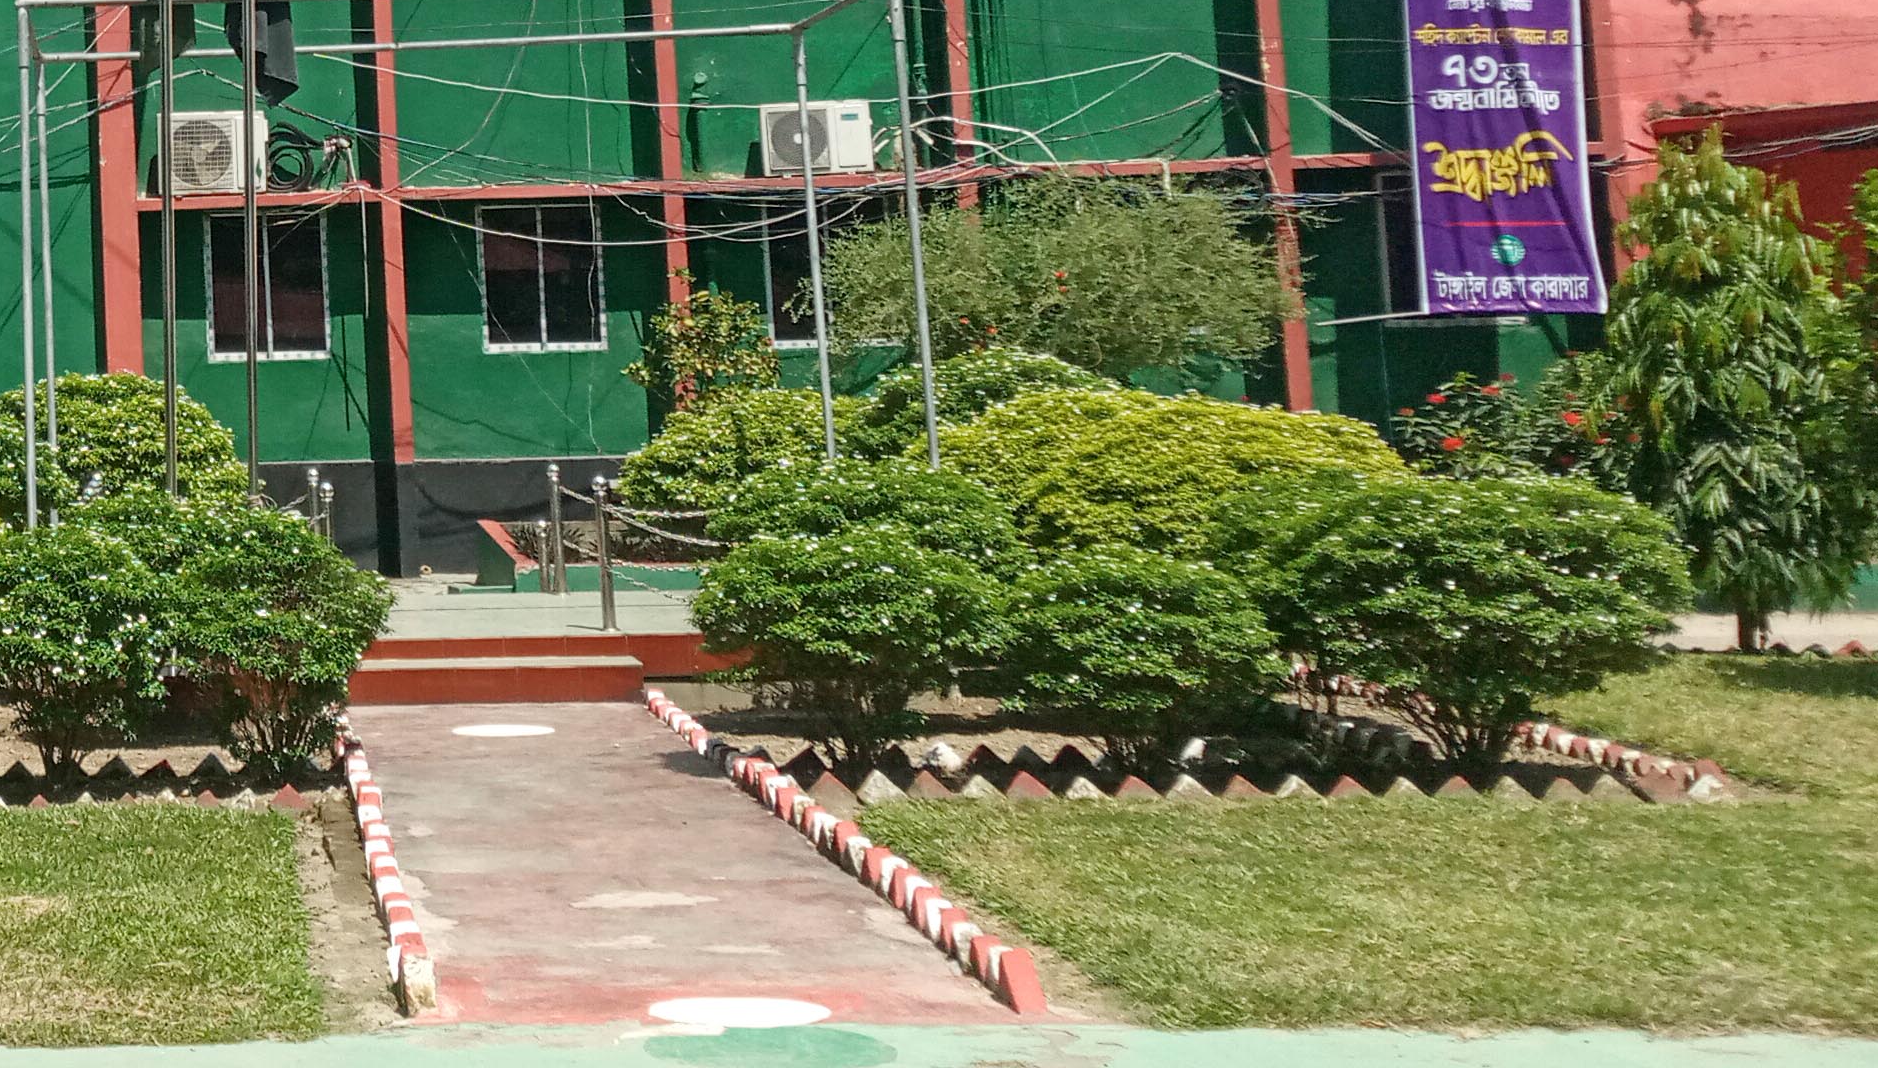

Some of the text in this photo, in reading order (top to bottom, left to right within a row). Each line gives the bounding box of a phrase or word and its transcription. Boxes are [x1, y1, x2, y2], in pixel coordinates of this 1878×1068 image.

[1423, 130, 1574, 202] শ্রদ্ধাঞ্জলি
[1431, 270, 1488, 304] টাঙ্গাইল
[1528, 274, 1589, 301] কারাগার
